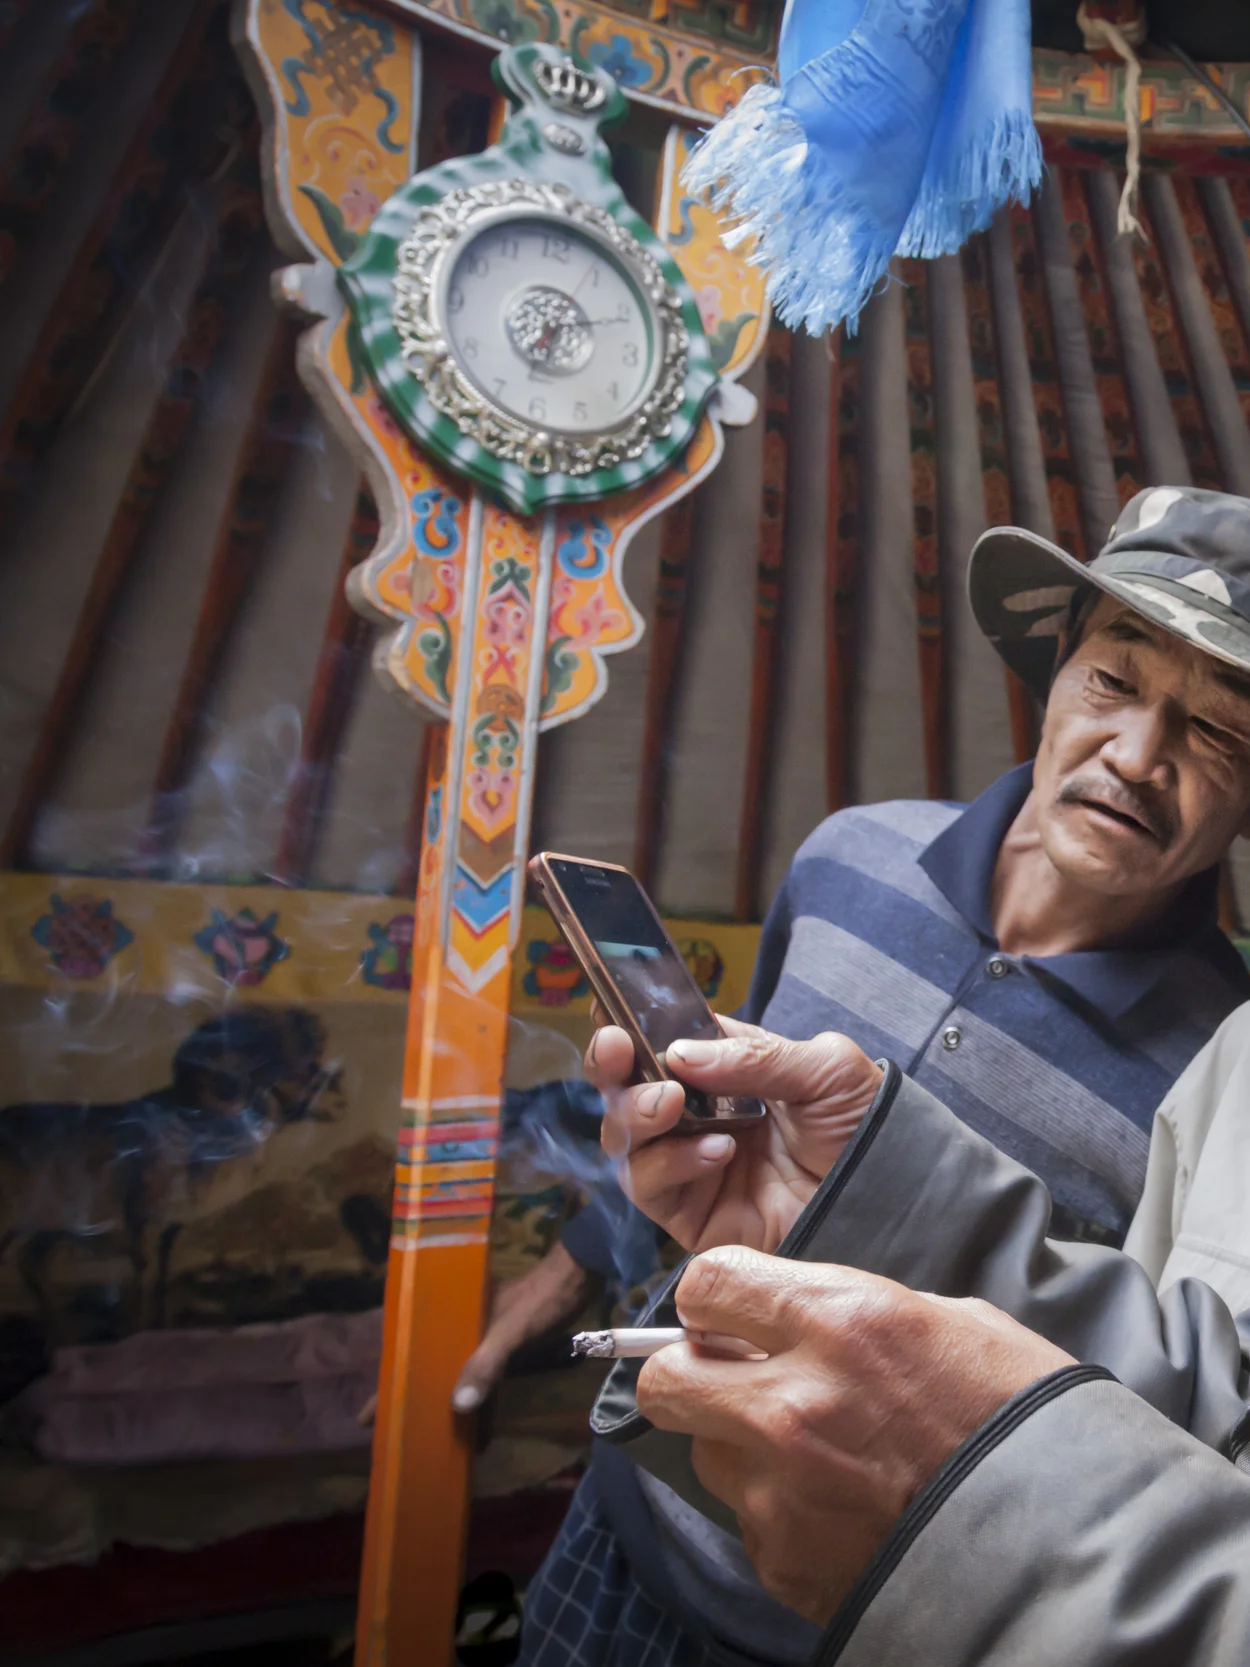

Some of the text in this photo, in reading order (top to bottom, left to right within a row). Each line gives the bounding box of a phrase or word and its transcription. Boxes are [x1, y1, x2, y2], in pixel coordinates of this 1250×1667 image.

[543, 236, 571, 264] 12
[622, 343, 638, 367] 3
[493, 377, 507, 398] 7
[606, 380, 619, 401] 4
[529, 397, 545, 419] 6
[572, 401, 588, 421] 5
